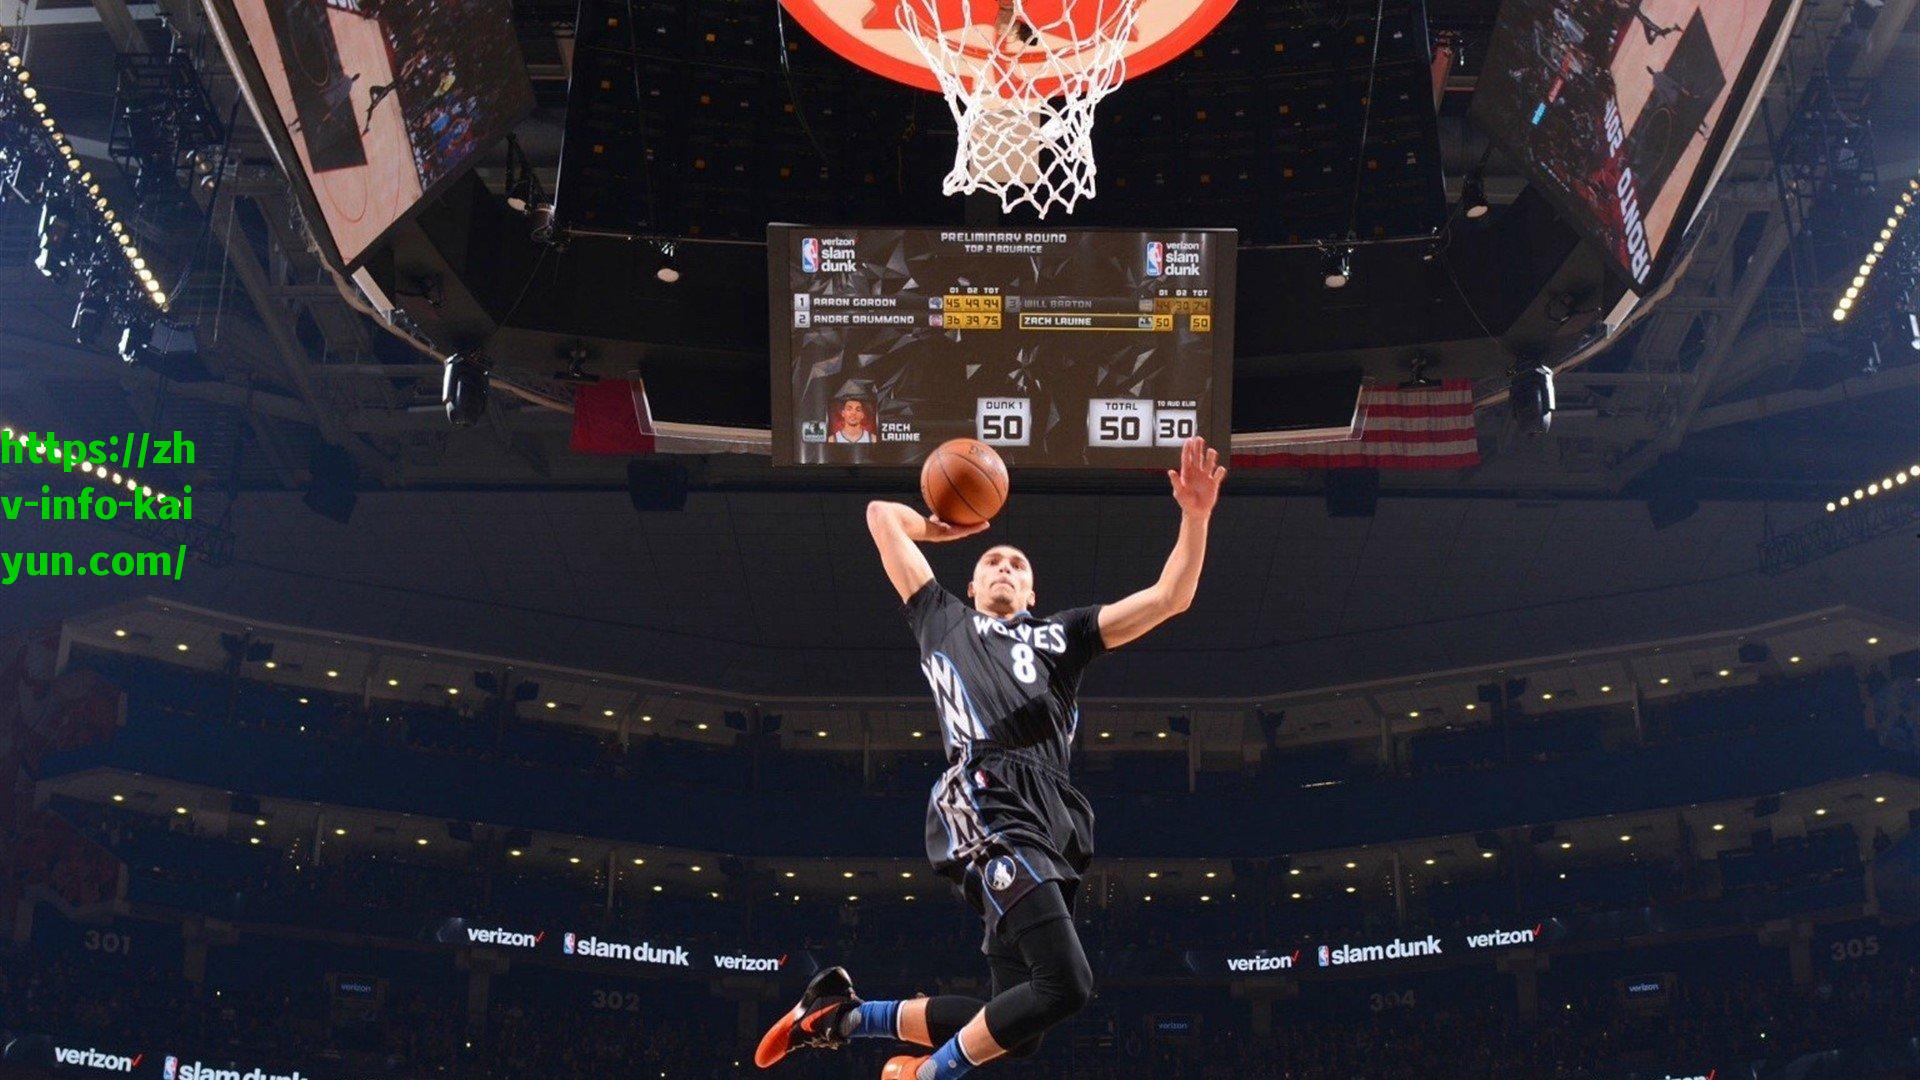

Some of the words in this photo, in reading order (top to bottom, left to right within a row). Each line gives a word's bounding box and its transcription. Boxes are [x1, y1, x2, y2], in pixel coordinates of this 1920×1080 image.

[1617, 167, 1650, 285] RONTO
[821, 238, 855, 247] verizon
[941, 232, 1021, 242] PRELIMINARY
[1025, 233, 1067, 243] ROUND
[965, 244, 984, 253] TOP
[986, 244, 993, 253] 2
[1166, 242, 1199, 250] verizon
[821, 247, 855, 260] slam
[1165, 251, 1199, 263] slam
[821, 260, 856, 273] dunk
[1165, 263, 1200, 276] dunk
[799, 297, 805, 307] 1
[813, 298, 850, 307] AARON
[852, 298, 897, 307] GORDON
[946, 299, 960, 308] 45
[965, 298, 980, 308] 49
[983, 299, 999, 308] 94
[799, 314, 807, 325] 2
[813, 315, 849, 324] ANDRE
[852, 315, 914, 324] DRUMMOND
[965, 315, 980, 325] 39
[984, 316, 999, 325] 75
[1024, 317, 1052, 325] ZACH
[1156, 317, 1170, 327] 50
[1193, 318, 1208, 327] 50
[986, 402, 1014, 410] DUNK
[1018, 402, 1023, 410] 1
[1105, 402, 1138, 411] TOTAL
[881, 423, 911, 432] ZACH
[983, 415, 1023, 440] 50
[1100, 416, 1140, 441] 50
[1159, 418, 1193, 439] 30
[973, 615, 1067, 654] WOLVES
[1011, 642, 1037, 684] 8
[84, 929, 132, 956] 301
[467, 927, 536, 948] verizon
[1466, 929, 1534, 949] verizon
[1830, 935, 1880, 961] 305
[714, 954, 779, 972] verizon
[1227, 955, 1292, 972] verizon
[54, 1046, 132, 1072] verizon
